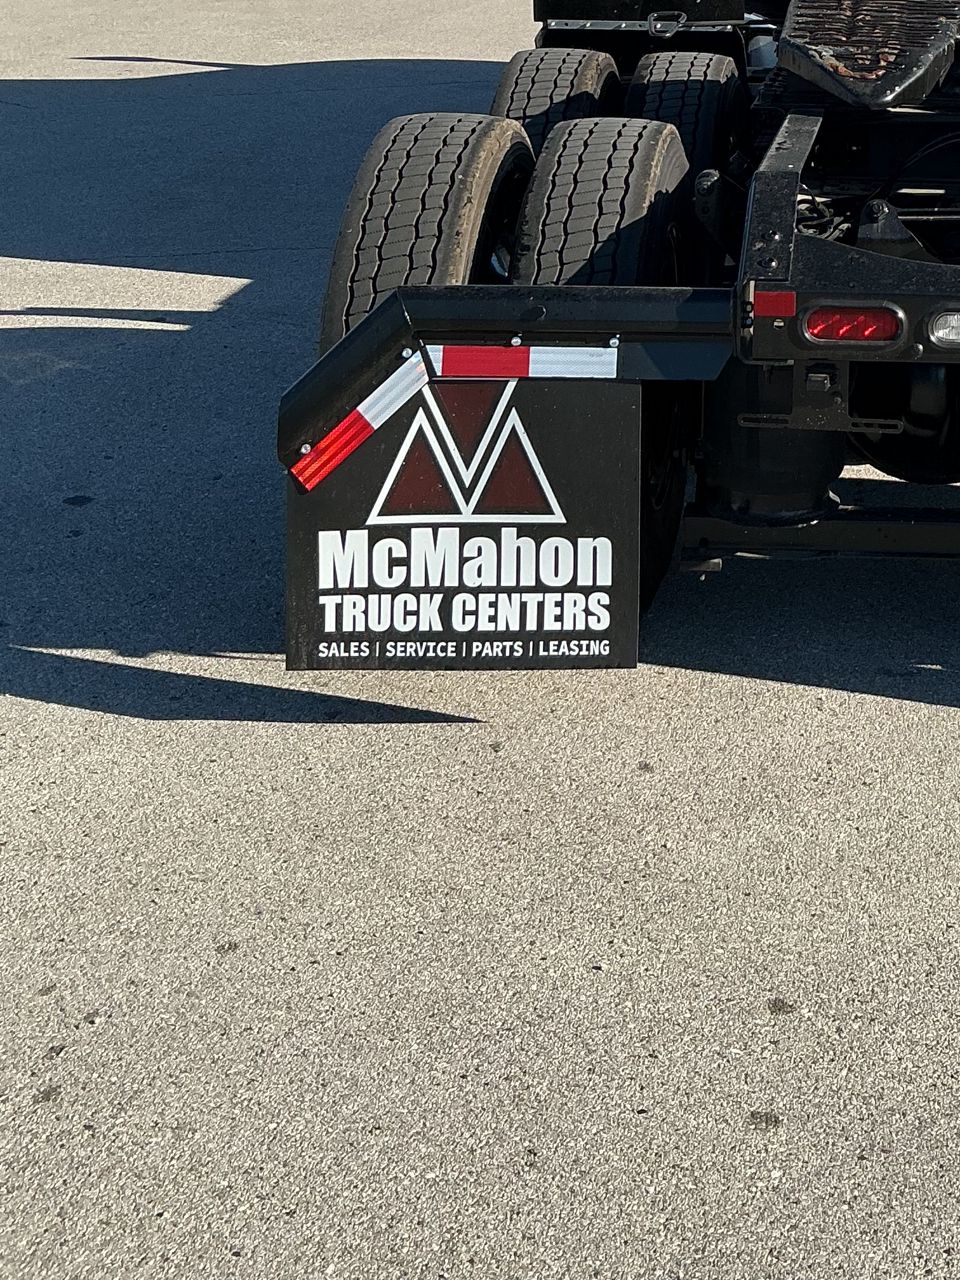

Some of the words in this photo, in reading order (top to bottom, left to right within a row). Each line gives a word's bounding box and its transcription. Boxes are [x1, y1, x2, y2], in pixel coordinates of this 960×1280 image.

[318, 527, 612, 589] McMahon
[319, 593, 443, 632] TRUCK
[452, 592, 610, 632] CENTERS
[318, 642, 370, 657] SALES
[386, 641, 456, 657] SERVICE
[472, 641, 523, 657] PARTS
[539, 640, 610, 656] LEASING
